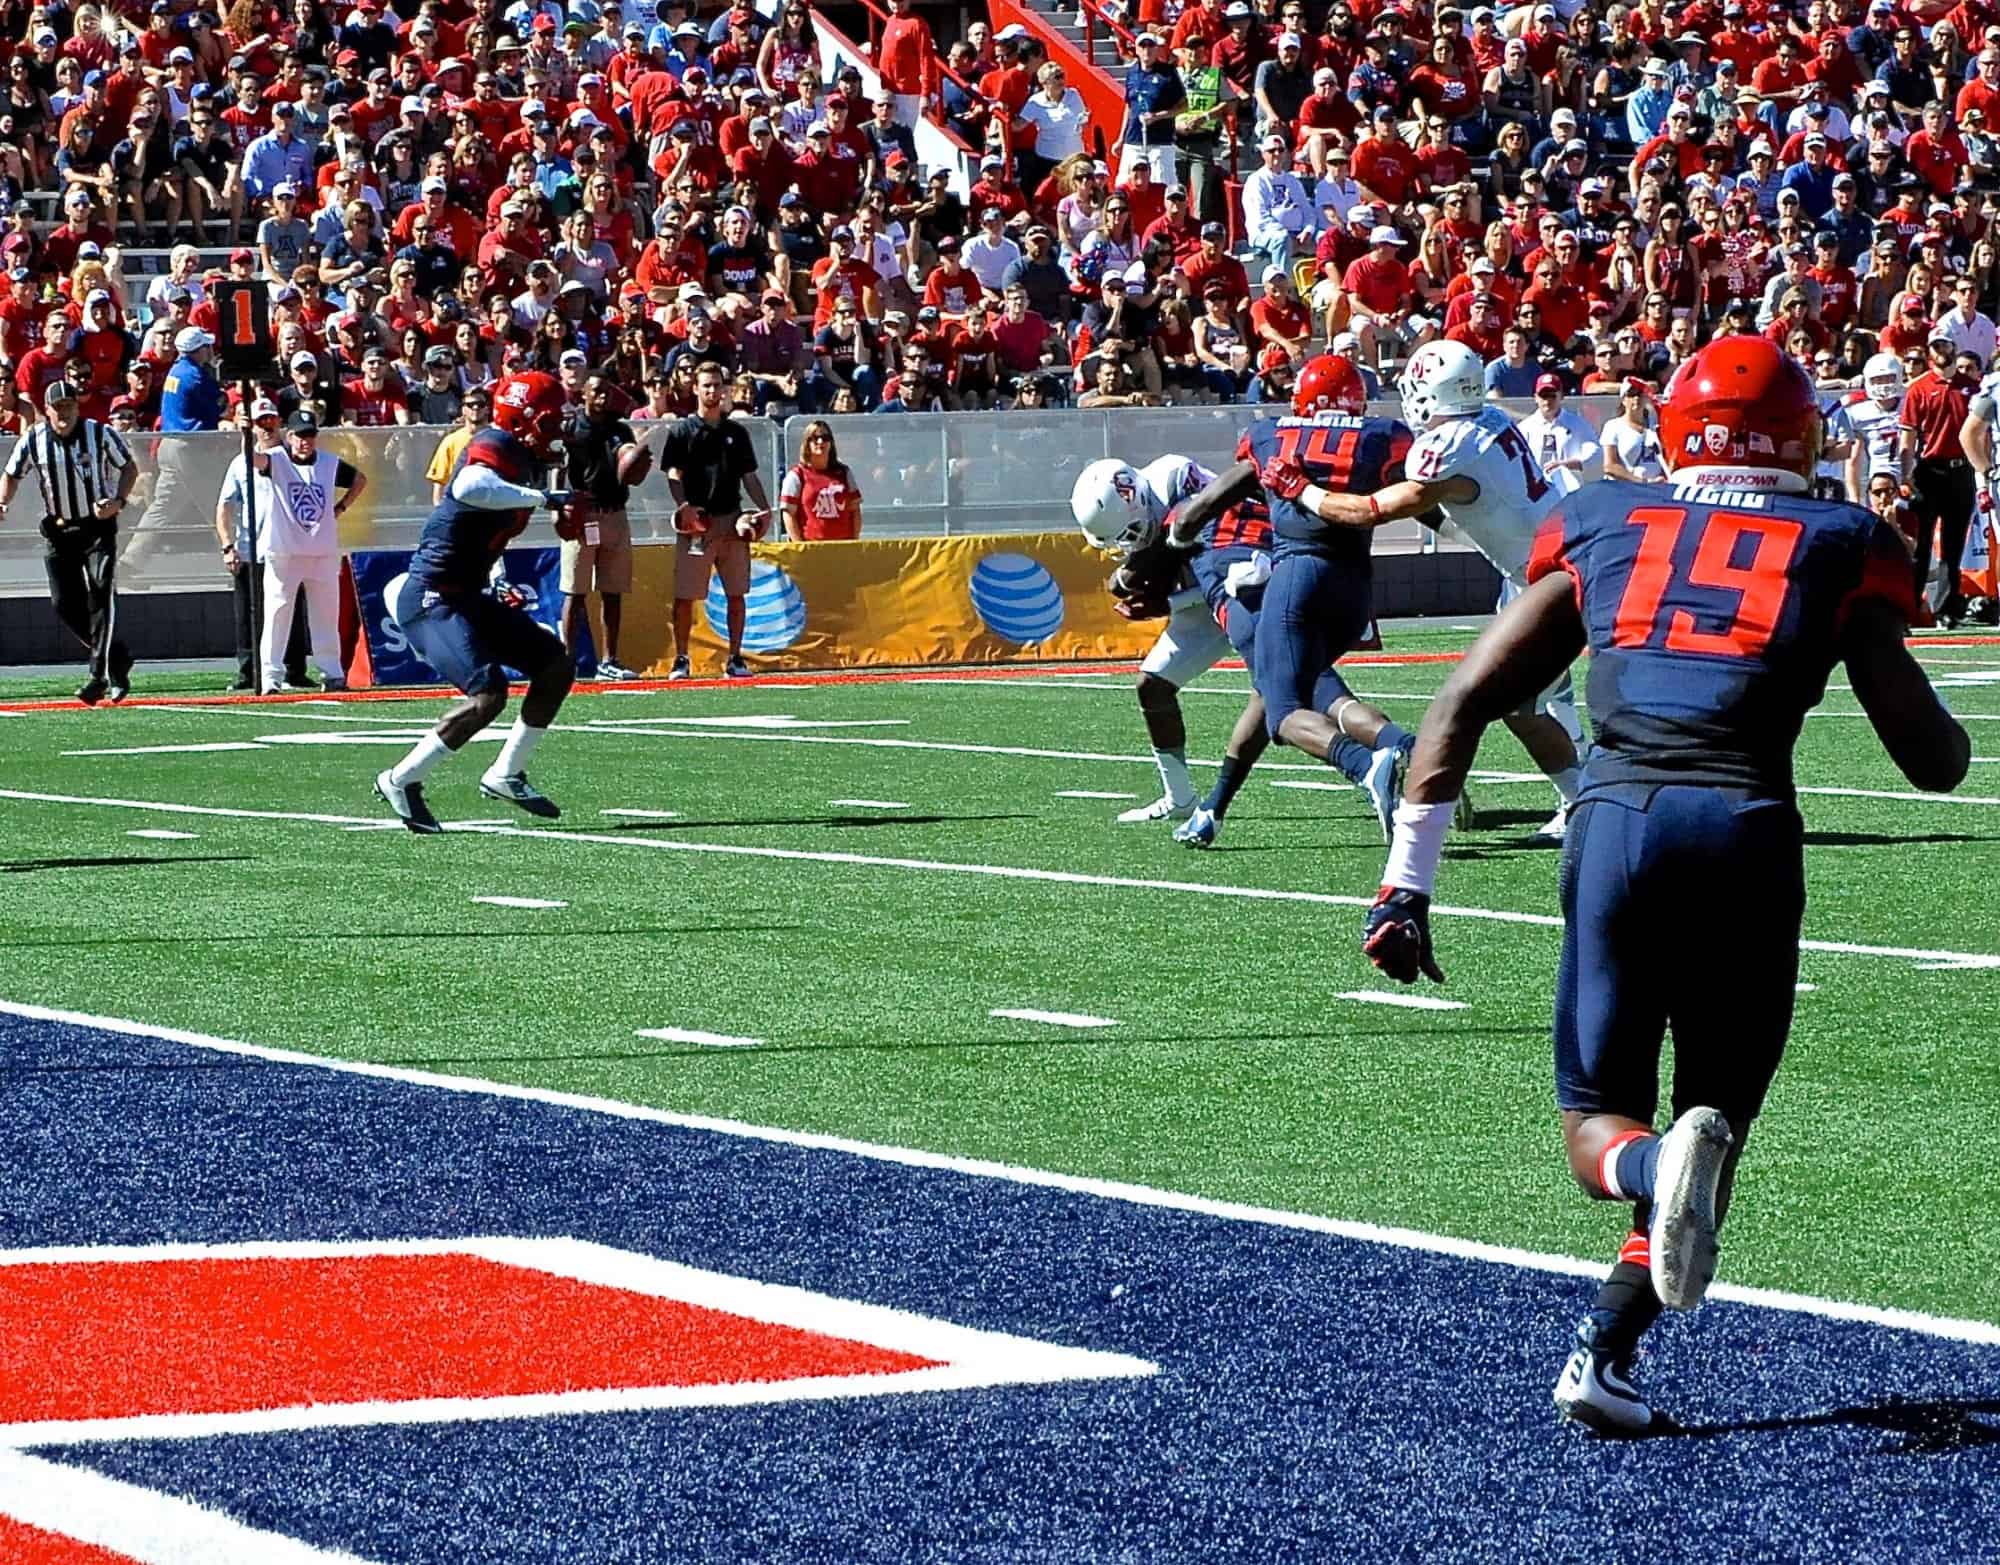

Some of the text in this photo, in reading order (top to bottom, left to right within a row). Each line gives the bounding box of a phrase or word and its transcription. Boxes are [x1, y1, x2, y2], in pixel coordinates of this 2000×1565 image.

[232, 289, 256, 345] 1
[1275, 429, 1359, 491] 14
[290, 485, 325, 507] PAC
[300, 507, 316, 521] 12
[1613, 507, 1805, 656] 19
